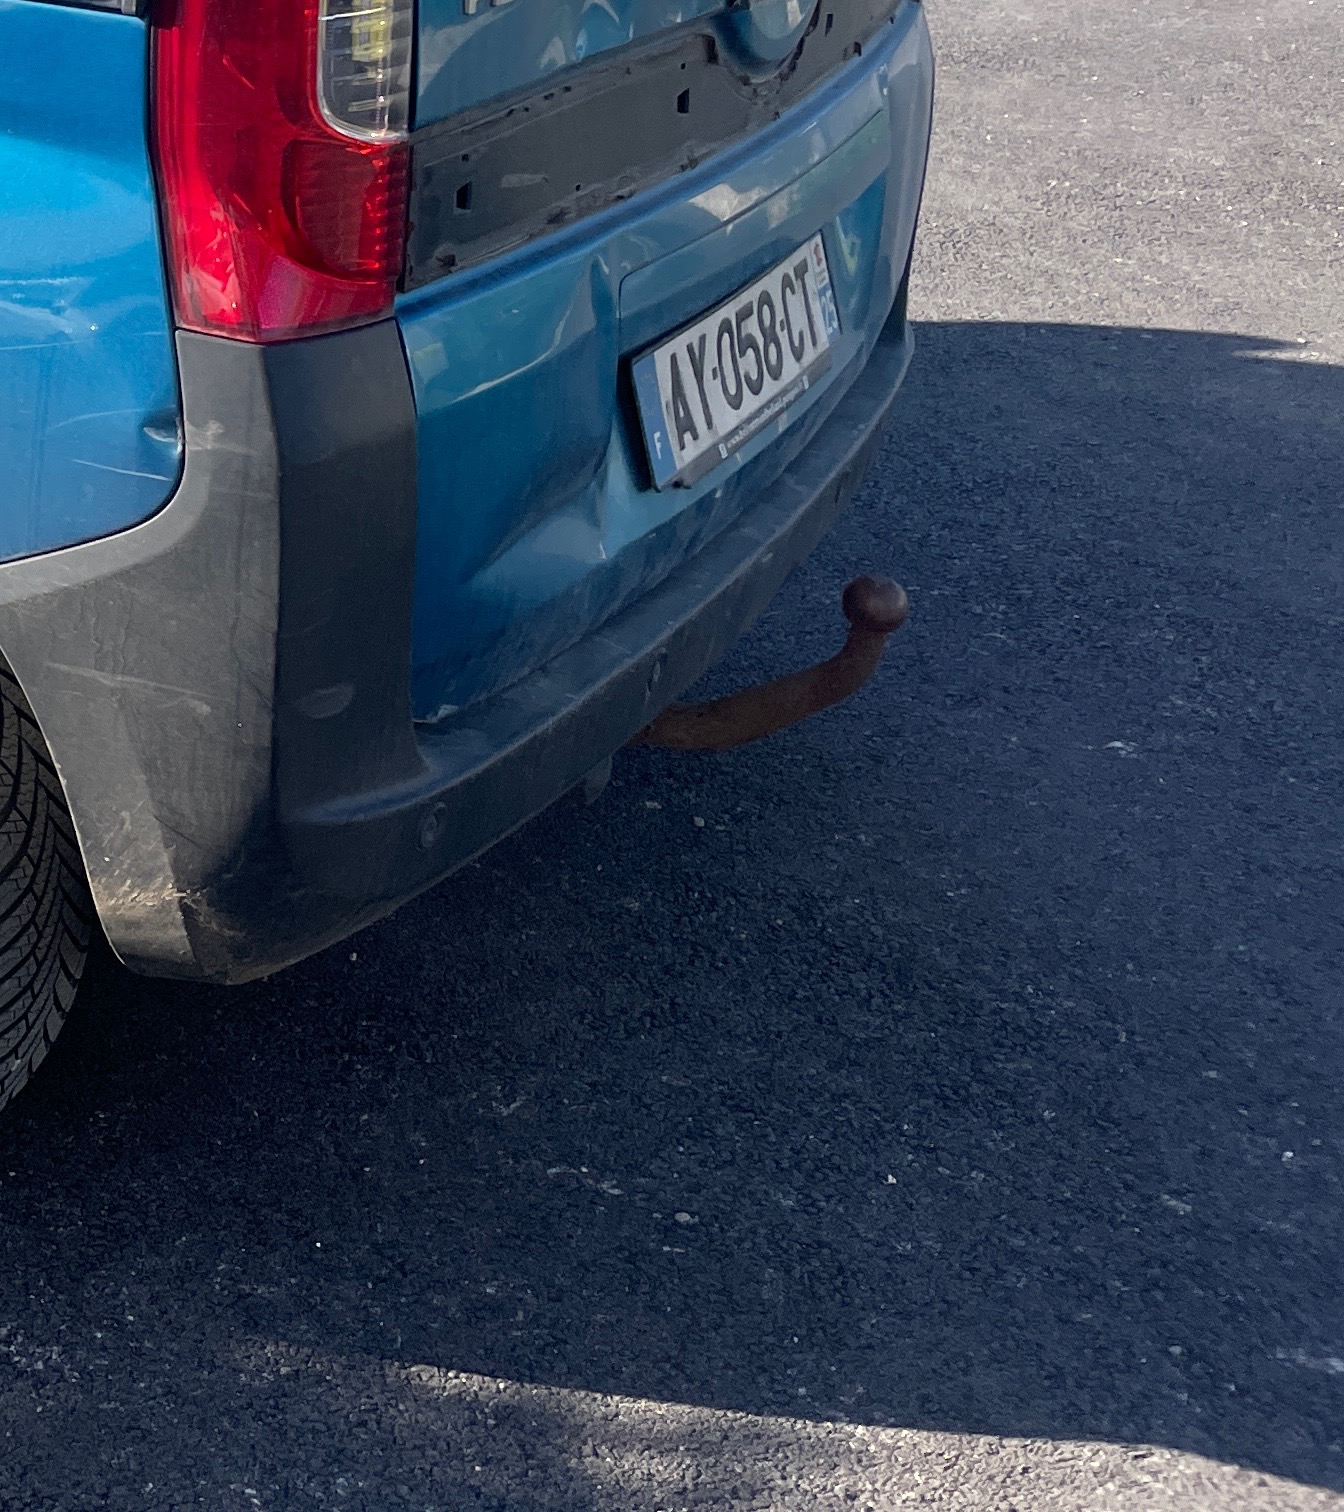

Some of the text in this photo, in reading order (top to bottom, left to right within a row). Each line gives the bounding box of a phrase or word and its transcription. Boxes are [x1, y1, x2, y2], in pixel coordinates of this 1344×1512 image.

[820, 289, 839, 336] 25
[669, 257, 818, 452] AY-058-CT
[653, 431, 662, 460] F
